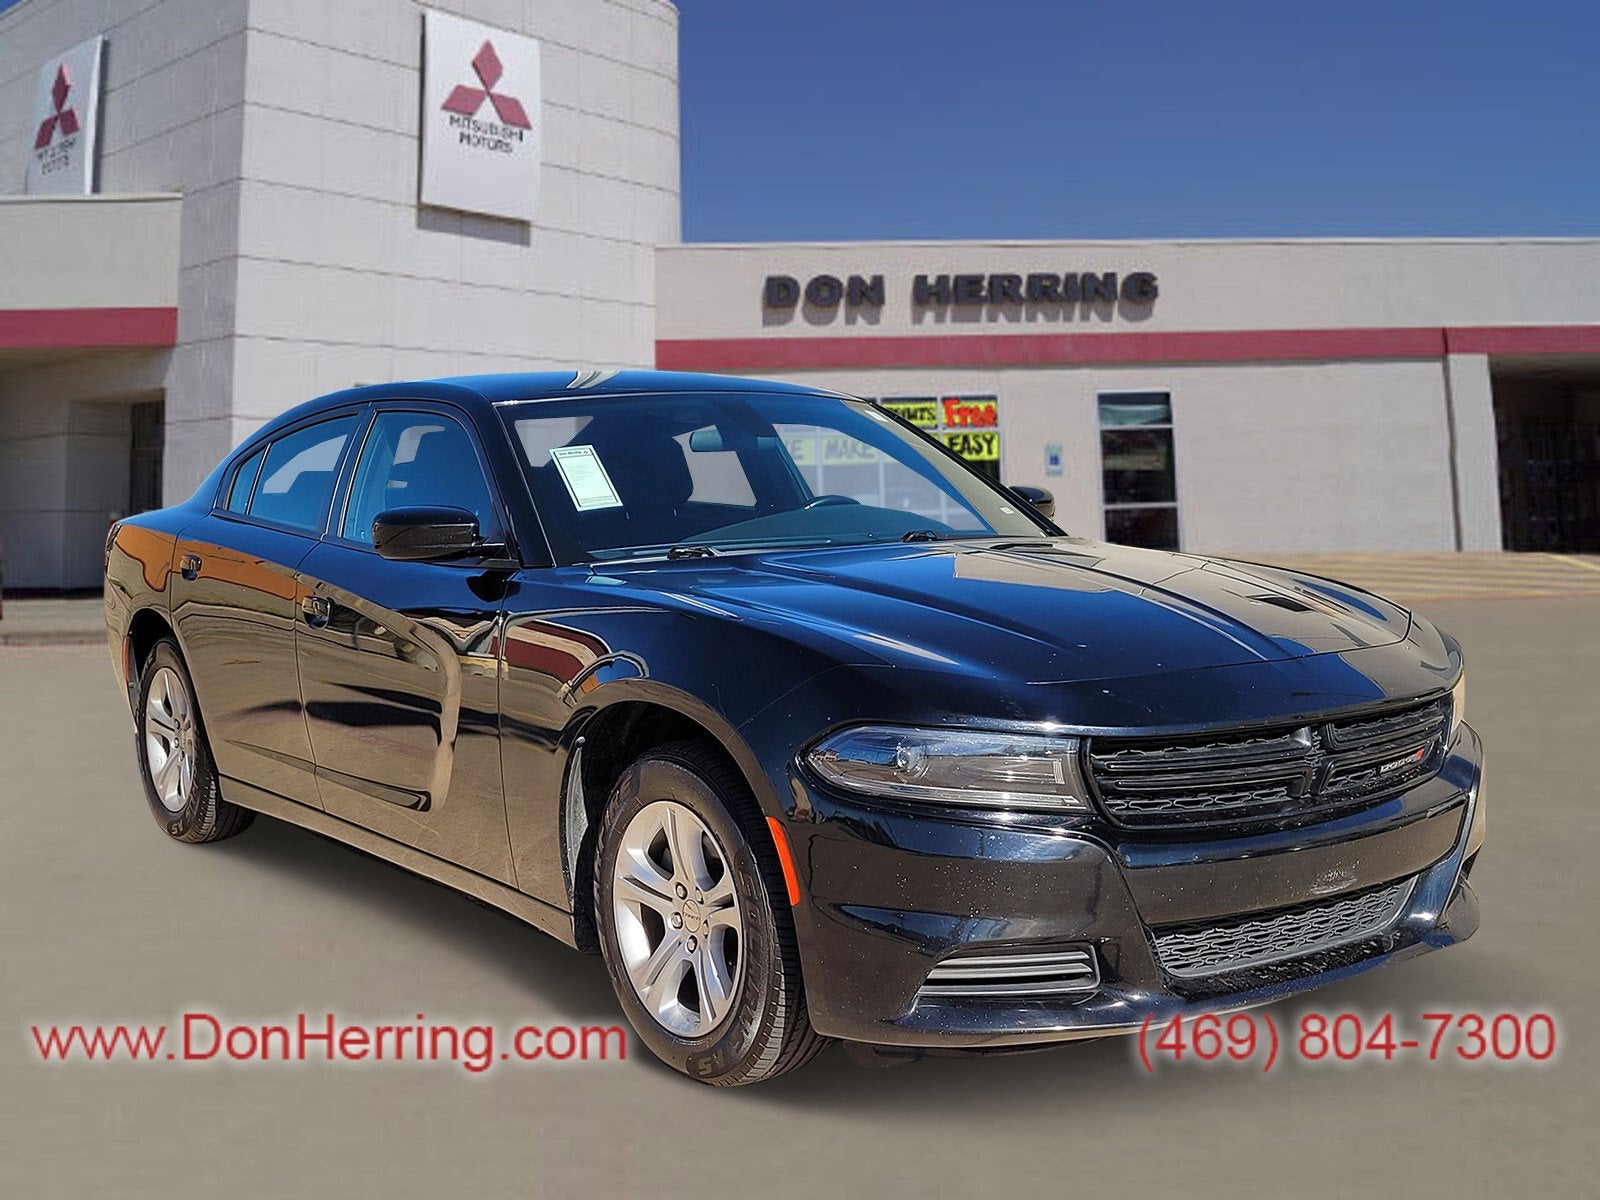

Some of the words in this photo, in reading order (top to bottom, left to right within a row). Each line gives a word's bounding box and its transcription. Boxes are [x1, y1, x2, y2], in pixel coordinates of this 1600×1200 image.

[459, 131, 513, 153] MOTORS
[764, 274, 885, 307] DON
[912, 272, 1159, 305] HERRING
[942, 398, 997, 428] Free
[947, 434, 996, 456] EASY
